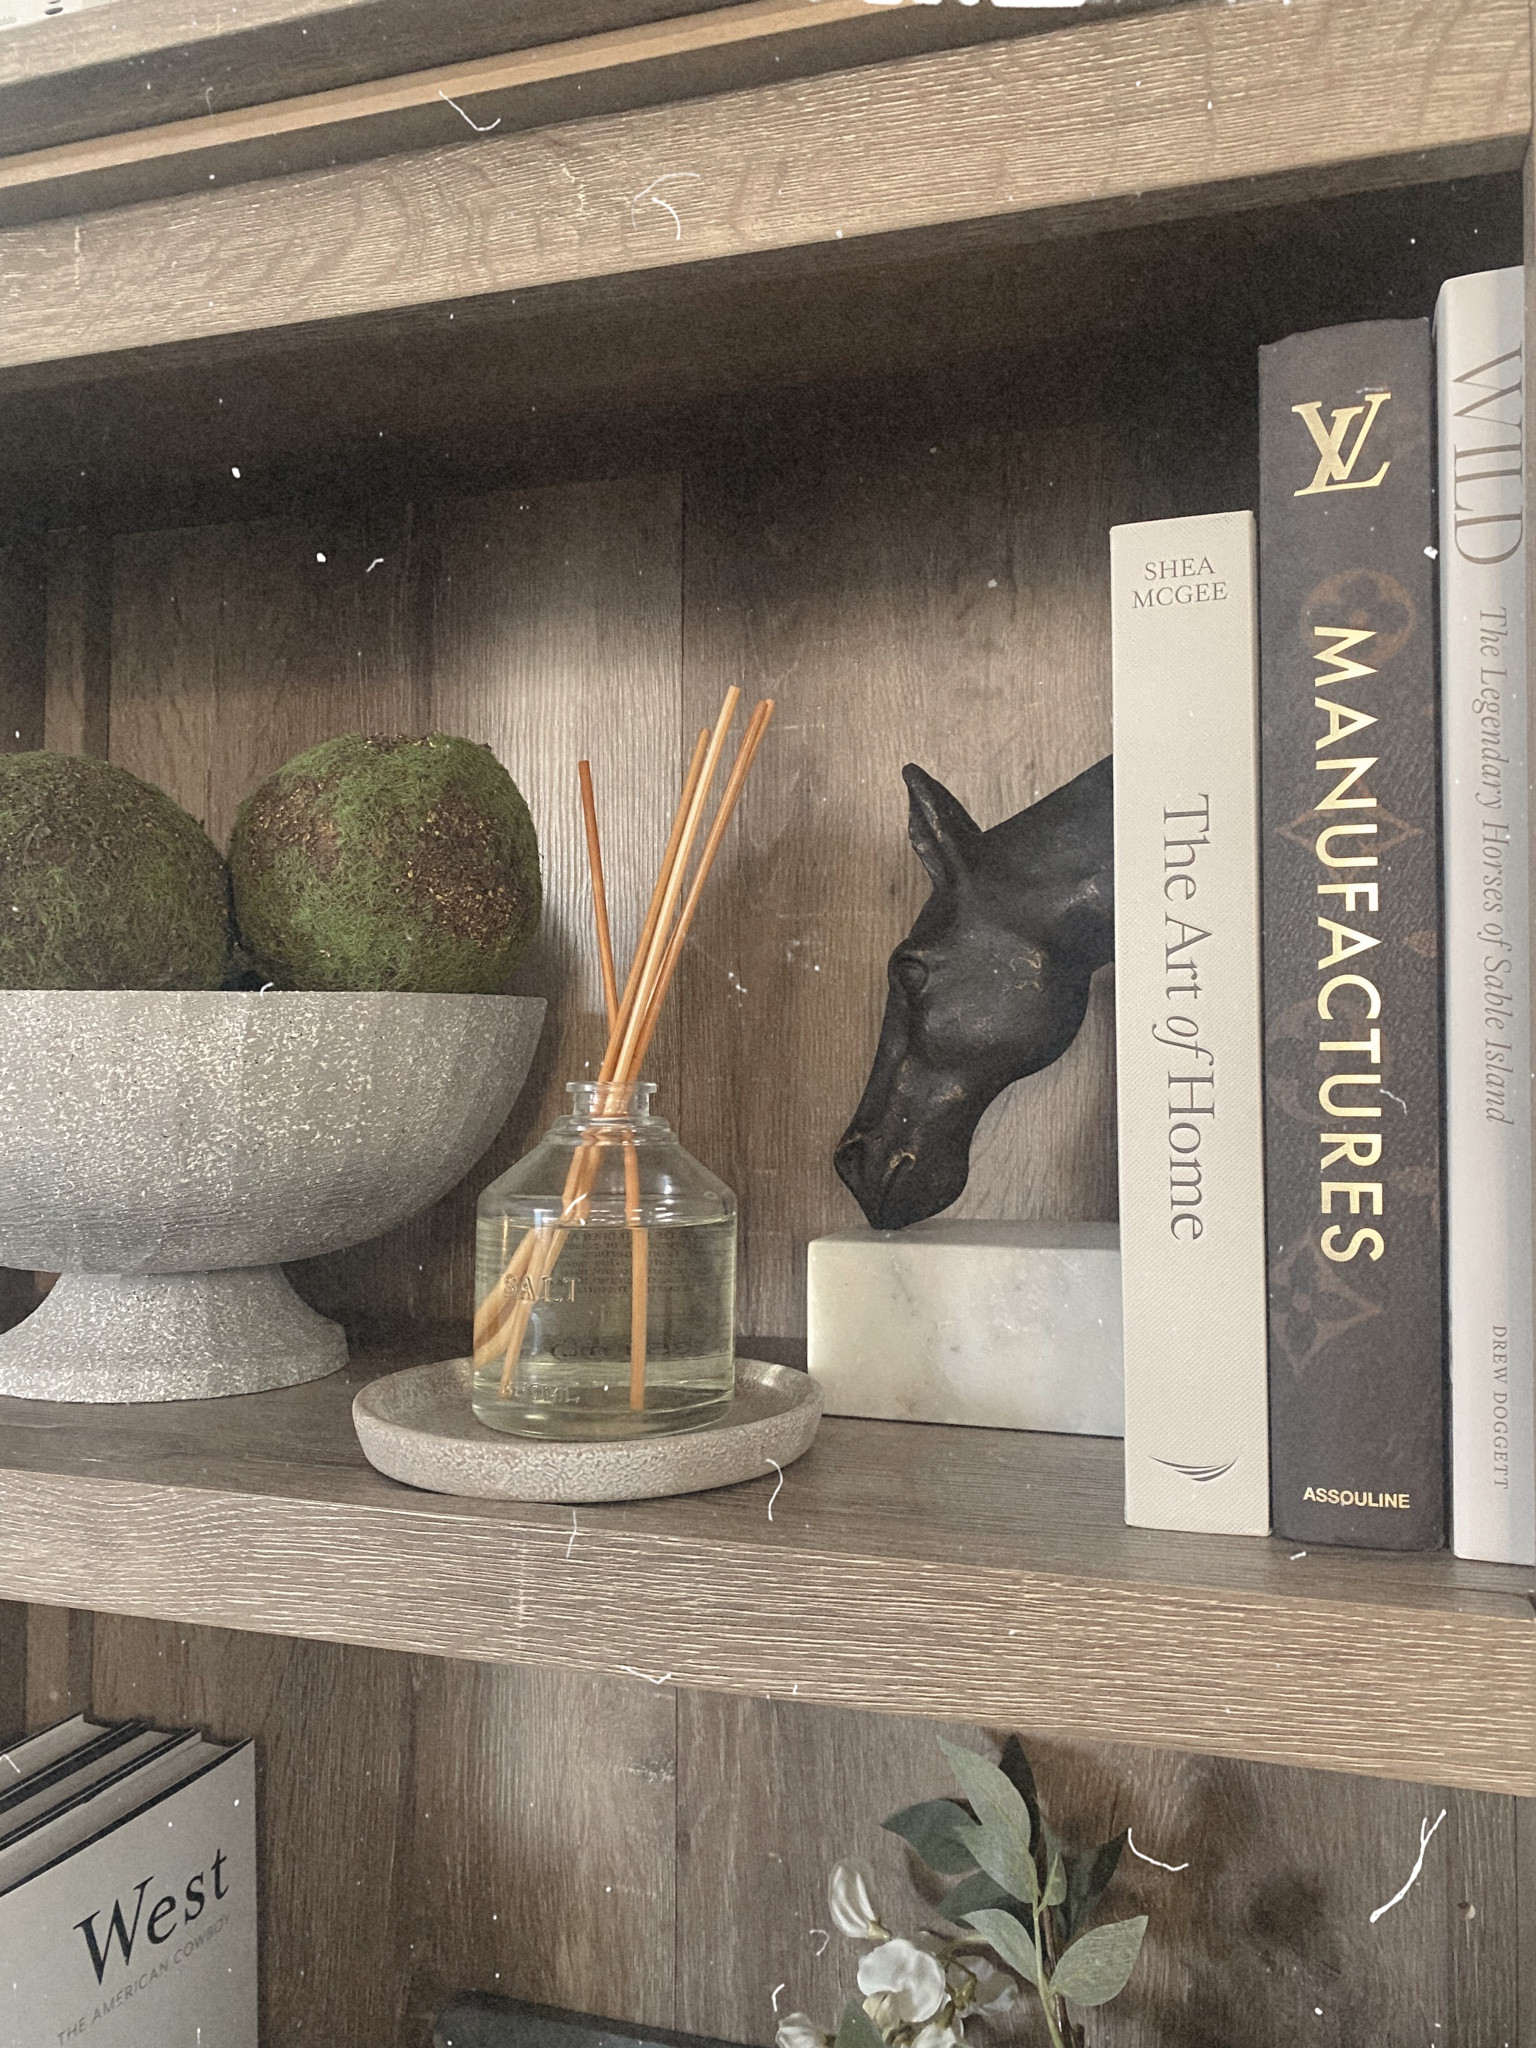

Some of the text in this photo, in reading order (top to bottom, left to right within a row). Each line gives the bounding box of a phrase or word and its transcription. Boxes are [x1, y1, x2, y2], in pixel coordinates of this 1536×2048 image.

[1452, 344, 1523, 565] WILD
[1132, 581, 1228, 609] MCGEE
[1144, 556, 1216, 581] SHEA
[1471, 607, 1514, 1126] The Legendary Horses of Sable Island
[1152, 793, 1216, 1240] The Art of Home
[1312, 625, 1385, 1263] MANUFACTURES
[1492, 1324, 1509, 1491] DREW DOGGETT
[1303, 1487, 1410, 1509] ASSOULINE
[57, 1912, 231, 2046] THE AMERICAN COWBOY
[73, 1848, 229, 1986] West
